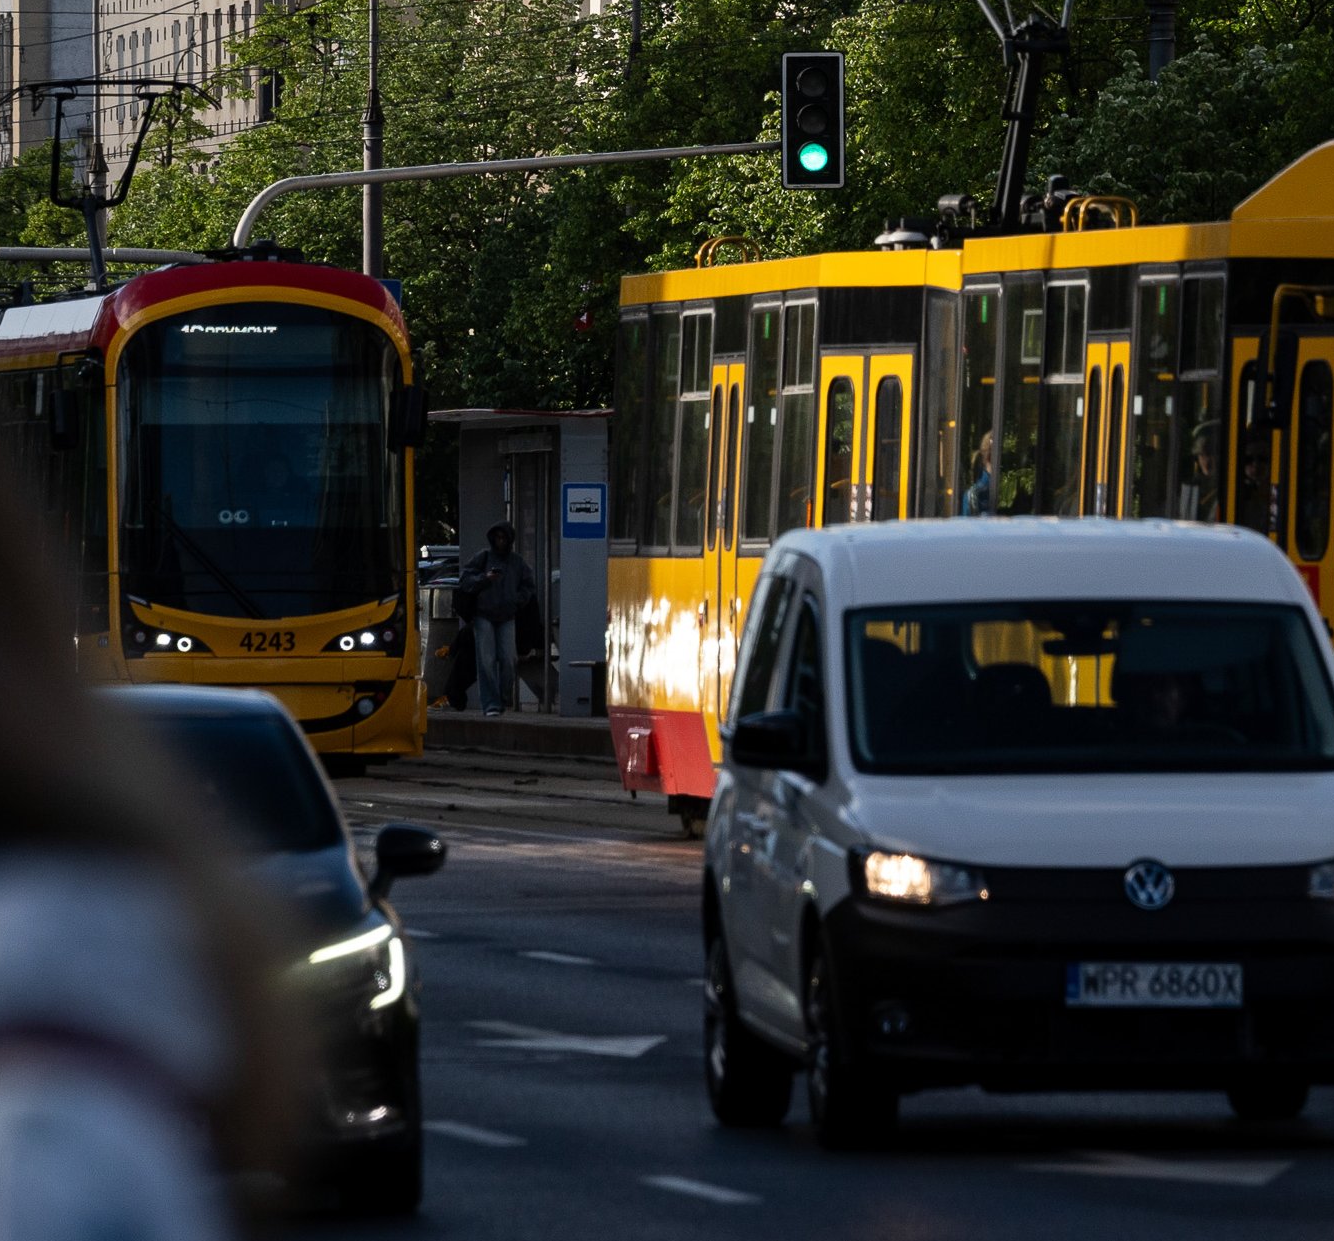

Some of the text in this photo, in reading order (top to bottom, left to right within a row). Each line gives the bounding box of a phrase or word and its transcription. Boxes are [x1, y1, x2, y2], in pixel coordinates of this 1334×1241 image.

[239, 631, 296, 652] 4243
[1082, 965, 1239, 998] WPR 6860X
